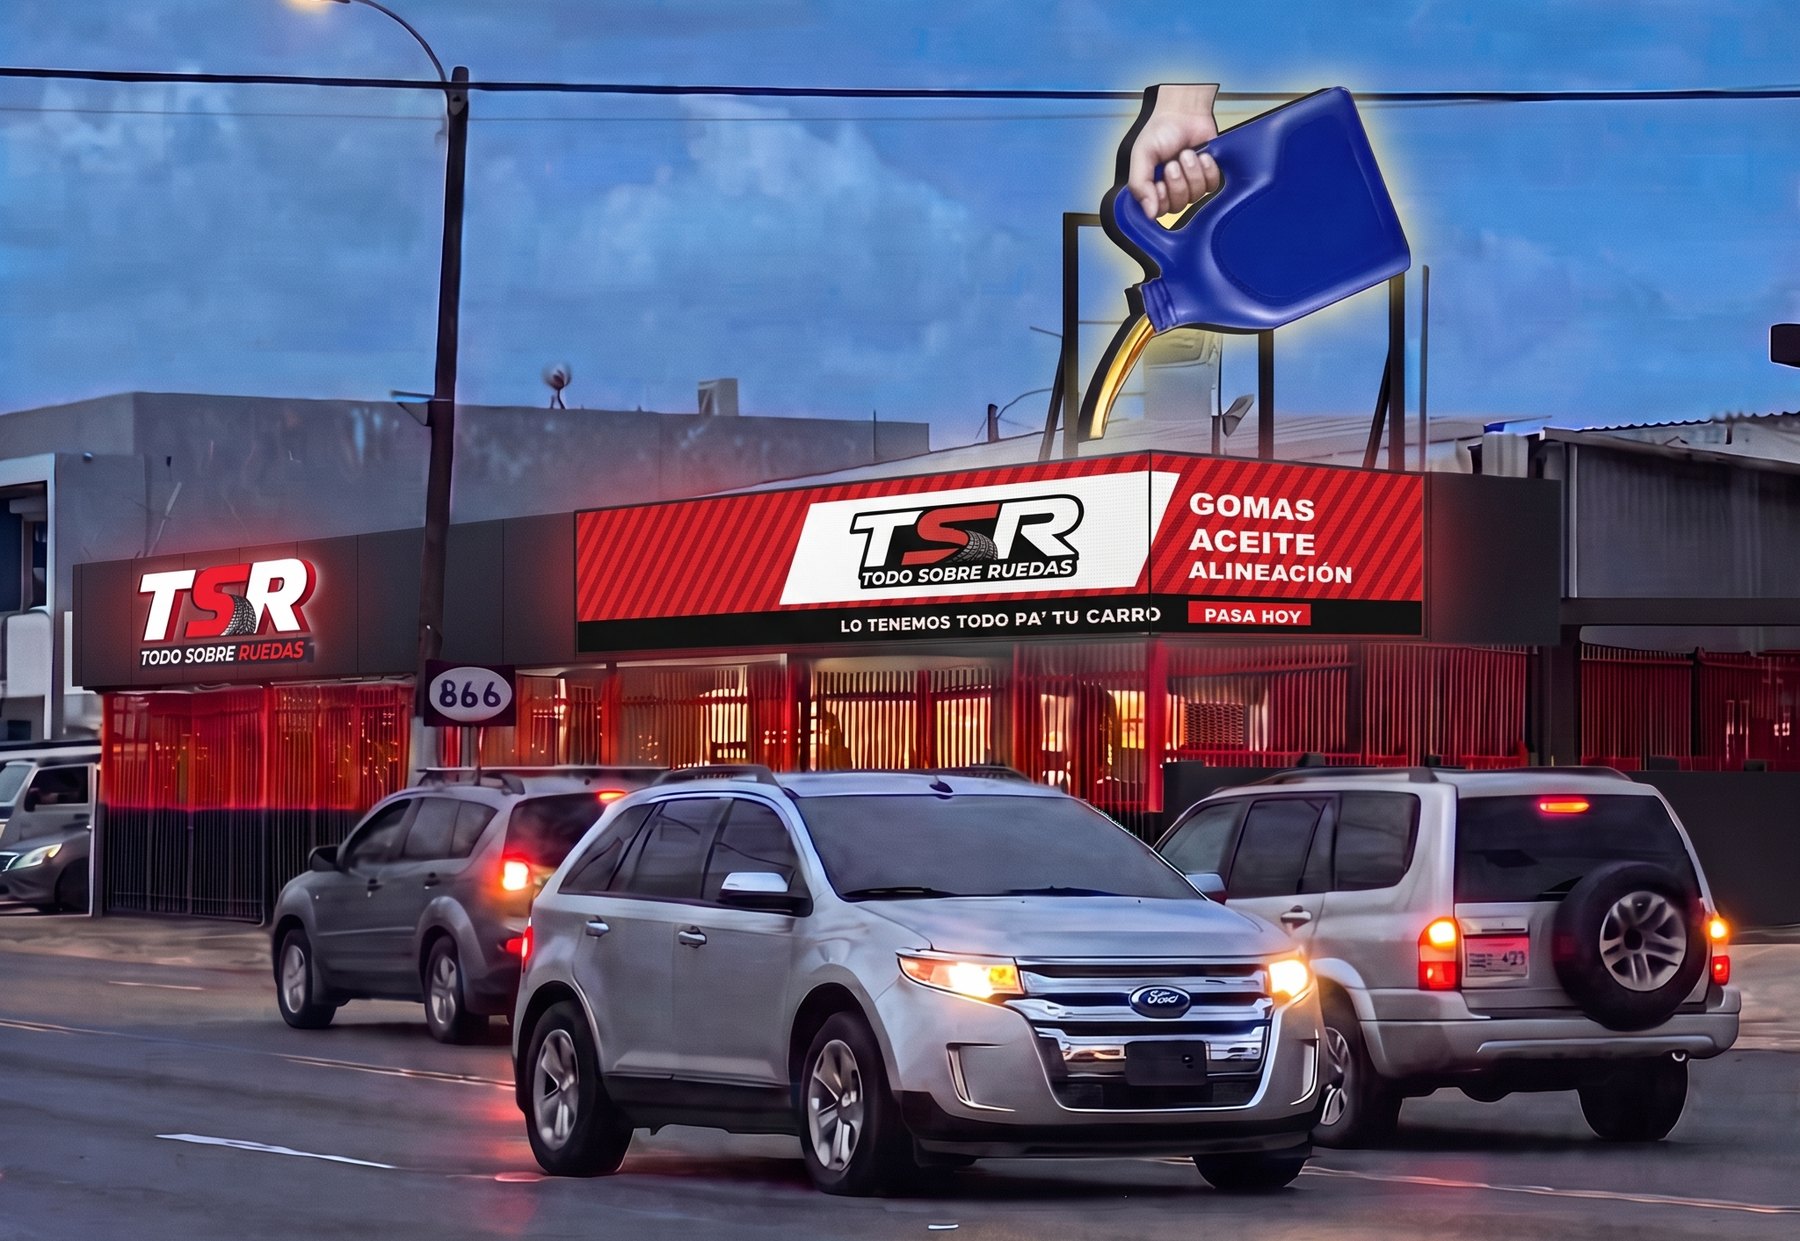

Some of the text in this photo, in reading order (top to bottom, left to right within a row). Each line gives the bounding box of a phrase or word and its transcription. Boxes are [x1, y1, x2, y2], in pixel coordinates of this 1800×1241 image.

[1189, 492, 1315, 521] GOMAS
[851, 494, 1084, 568] TSR
[1188, 528, 1315, 556] ACEITE
[862, 559, 1073, 587] TODO SOBRE RUEDAS
[1188, 561, 1352, 584] ALINEACIÓN
[139, 558, 315, 641] TSR
[841, 619, 862, 633] LO
[868, 615, 951, 632] TENEMOS
[957, 612, 1009, 629] TODO
[1052, 609, 1079, 625] TU
[1086, 607, 1161, 624] CARRO
[1205, 608, 1302, 624] PASA HOY
[141, 640, 304, 666] TODO SOBRE RUEDAS
[439, 679, 502, 708] 866
